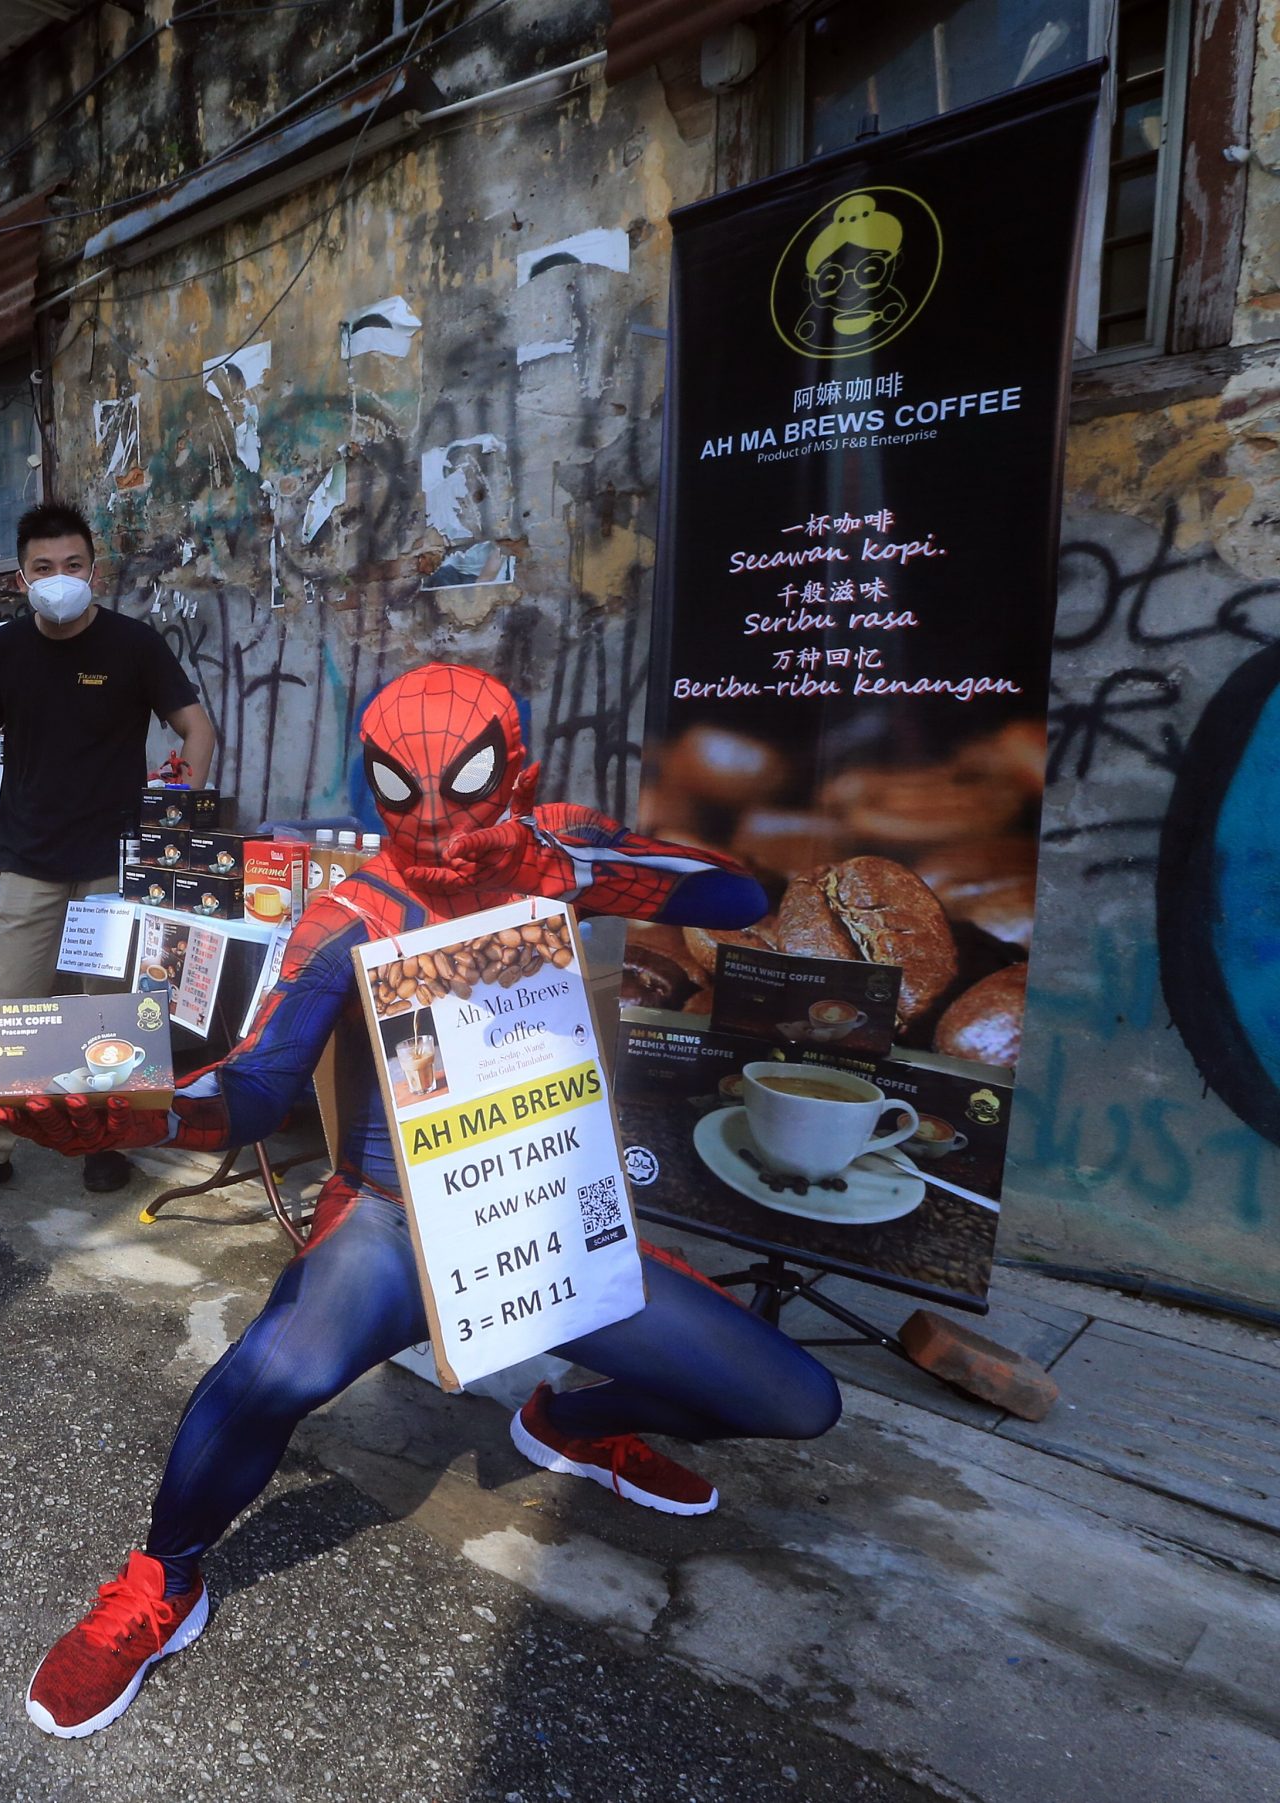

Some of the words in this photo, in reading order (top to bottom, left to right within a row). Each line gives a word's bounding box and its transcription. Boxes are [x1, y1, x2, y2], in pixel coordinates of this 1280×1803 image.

[793, 371, 904, 414] 阿嫲咖啡
[699, 437, 733, 461] AH
[740, 425, 778, 453] MA
[784, 410, 885, 445] BREWS
[894, 387, 1022, 429] COFFEE
[757, 444, 799, 464] Product
[800, 442, 812, 457] of
[814, 436, 839, 453] MSJ
[842, 432, 868, 450] F&B
[870, 427, 938, 449] Enterprise
[781, 508, 895, 537] 一杯咖啡
[728, 544, 849, 574] Secawan
[861, 534, 947, 566] kopi.
[777, 577, 890, 608] 千般滋味
[743, 608, 836, 636] Seribu
[849, 608, 920, 632] rasa
[772, 646, 883, 672] 万种回忆
[673, 674, 840, 700] Beribu-ribu
[853, 674, 1022, 702] kenangan
[245, 858, 289, 877] Caramel
[725, 961, 757, 974] PREMIX
[760, 968, 786, 979] WHITE
[789, 974, 826, 984] COFFEE
[2, 1005, 20, 1014] MA
[22, 1003, 59, 1013] BREWS
[456, 1004, 481, 1028] Ah
[484, 996, 515, 1021] Ma
[516, 980, 570, 1010] Brews
[25, 1016, 63, 1025] COFFEE
[490, 1018, 546, 1050] Coffee
[628, 1038, 666, 1050] PREMIX
[668, 1044, 698, 1054] WHITE
[701, 1048, 734, 1058] COFFEE
[630, 1028, 645, 1038] AH
[648, 1031, 664, 1040] MA
[666, 1034, 701, 1044] BREWS
[477, 1070, 498, 1082] Tiada
[498, 1064, 516, 1075] Gula
[516, 1052, 554, 1070] Tambahan
[803, 1051, 817, 1060] AH
[876, 1077, 918, 1094] COFFEE
[412, 1119, 452, 1155] AH
[459, 1103, 507, 1138] MA
[512, 1069, 602, 1120] BREWS
[443, 1154, 504, 1196] KOPI
[509, 1127, 580, 1170] TARIK
[474, 1195, 520, 1226] KAW
[524, 1176, 567, 1208] KAW
[593, 1234, 610, 1246] SCAN
[610, 1231, 618, 1240] ME
[450, 1268, 468, 1294] 1
[474, 1266, 490, 1282] =
[496, 1238, 540, 1277] RM
[546, 1231, 562, 1255] 4
[458, 1318, 473, 1342] 3
[480, 1315, 494, 1330] =
[500, 1289, 542, 1324] RM
[548, 1276, 577, 1306] 11
